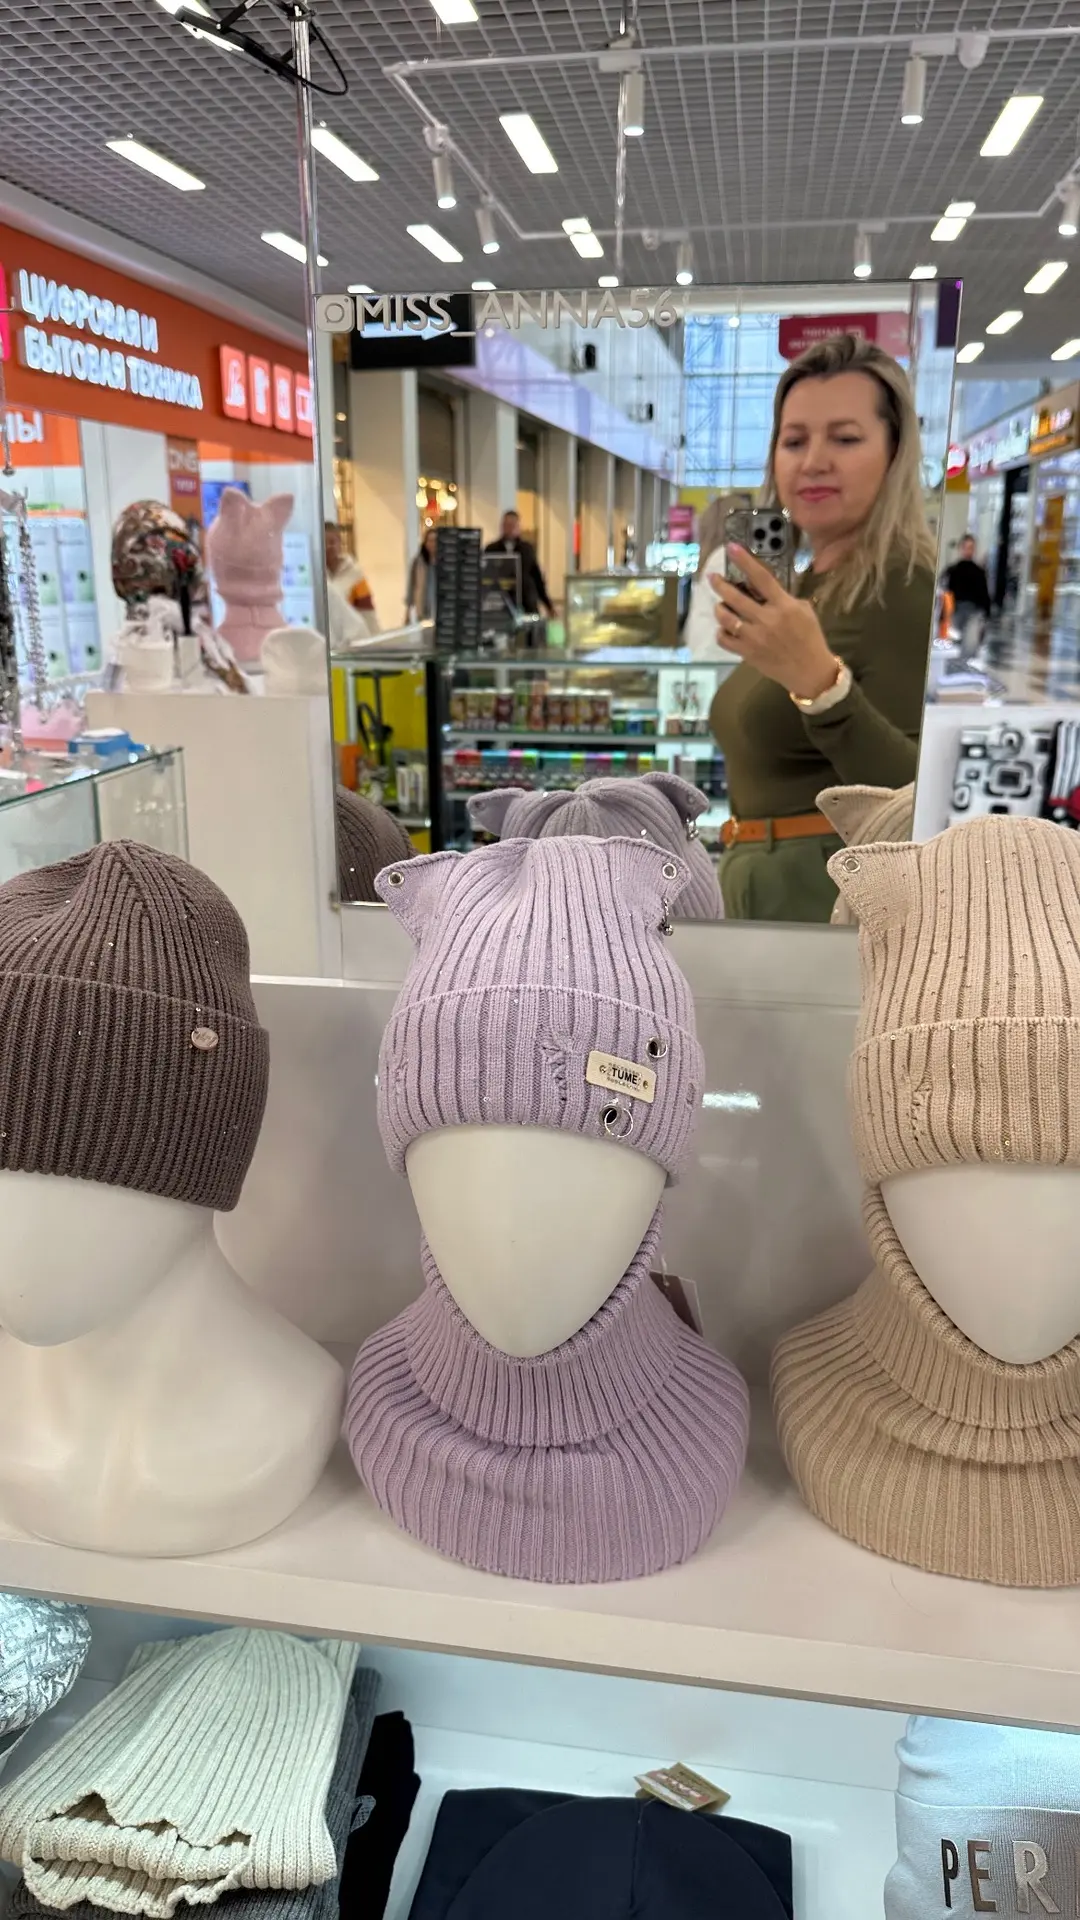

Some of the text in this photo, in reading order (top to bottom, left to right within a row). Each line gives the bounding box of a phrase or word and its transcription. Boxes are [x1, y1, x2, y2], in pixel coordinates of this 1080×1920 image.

[19, 268, 158, 353] ЦИФРОВАЯ И
[24, 325, 204, 410] БЫТОВАЯ ТЕХНИКА
[941, 1838, 1080, 1917] PER
